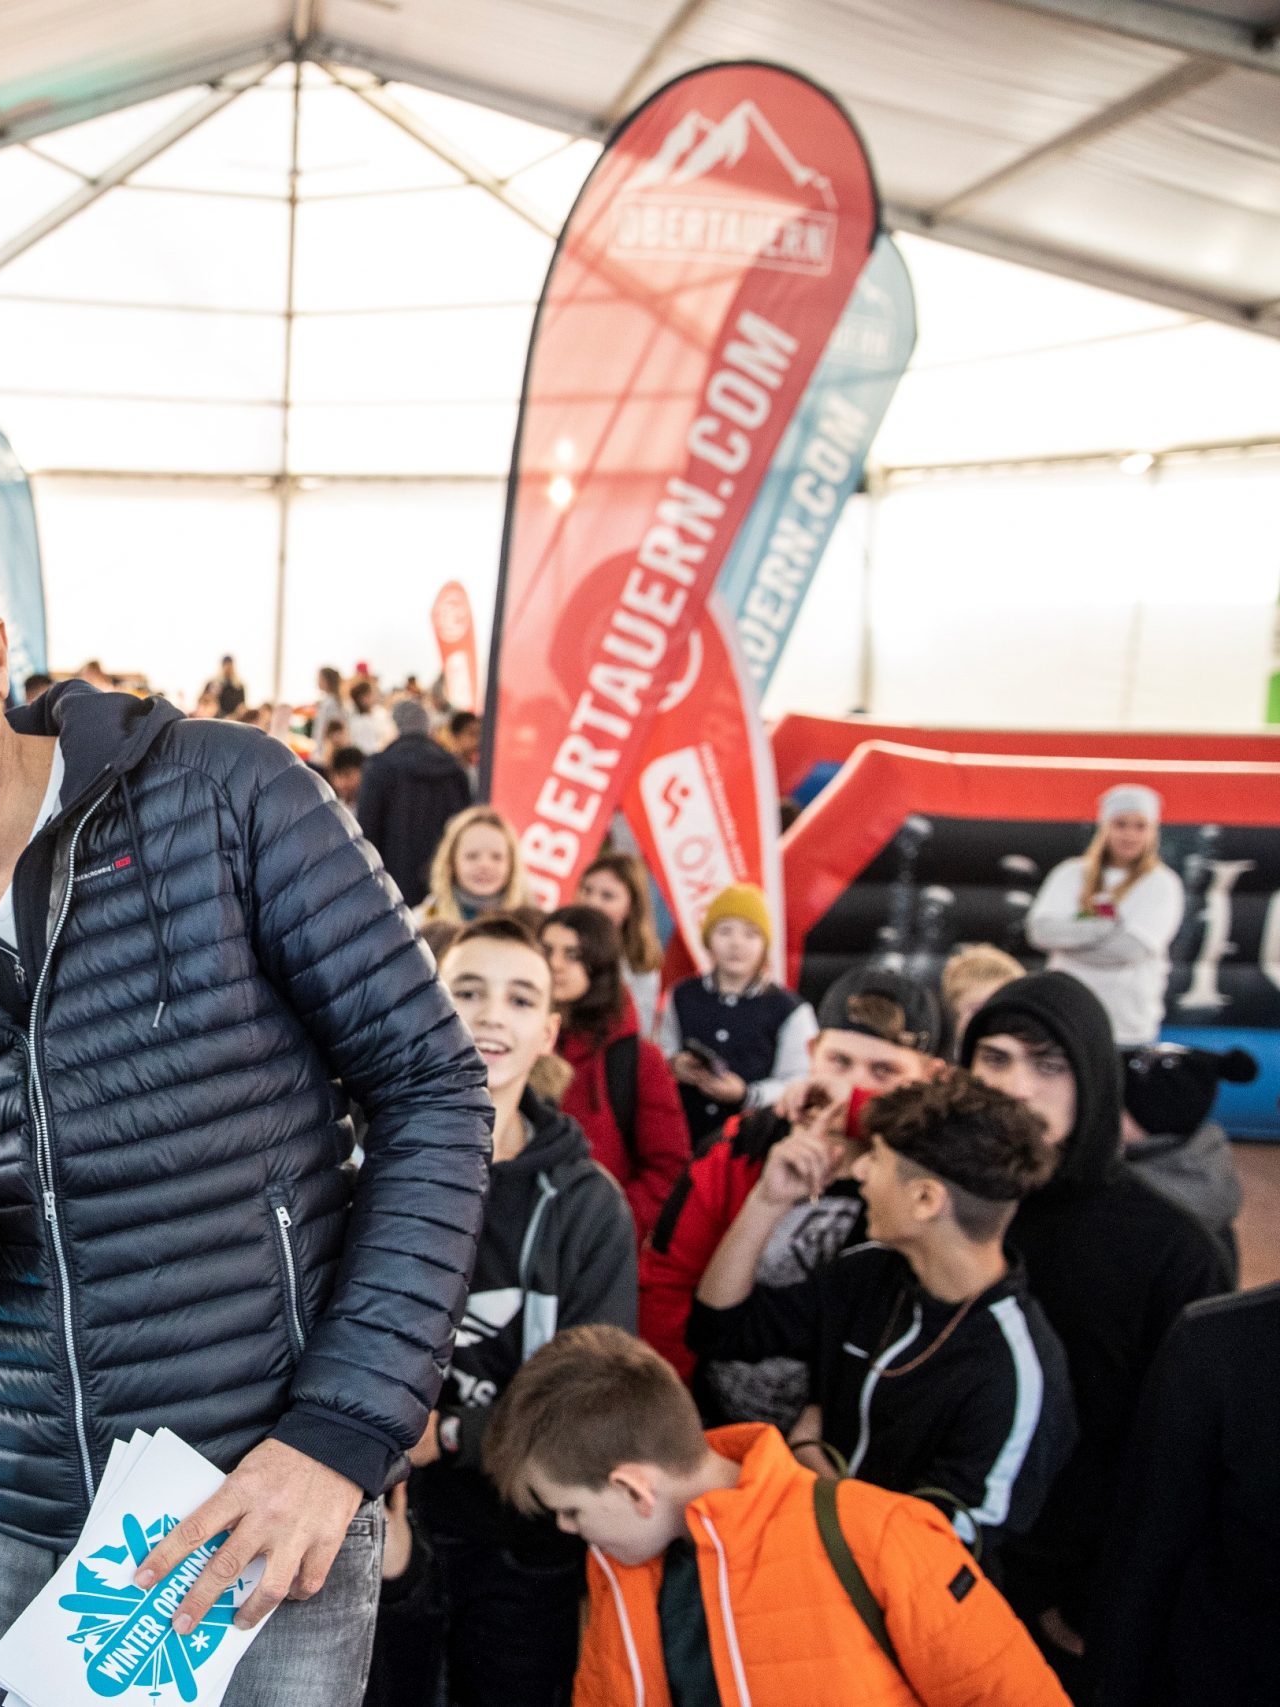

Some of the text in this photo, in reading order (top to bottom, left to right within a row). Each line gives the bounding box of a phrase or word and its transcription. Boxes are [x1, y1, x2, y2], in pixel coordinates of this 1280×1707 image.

[617, 205, 827, 261] OBERTAUERN
[736, 390, 870, 680] UERN.COM
[96, 1614, 166, 1684] WINTER
